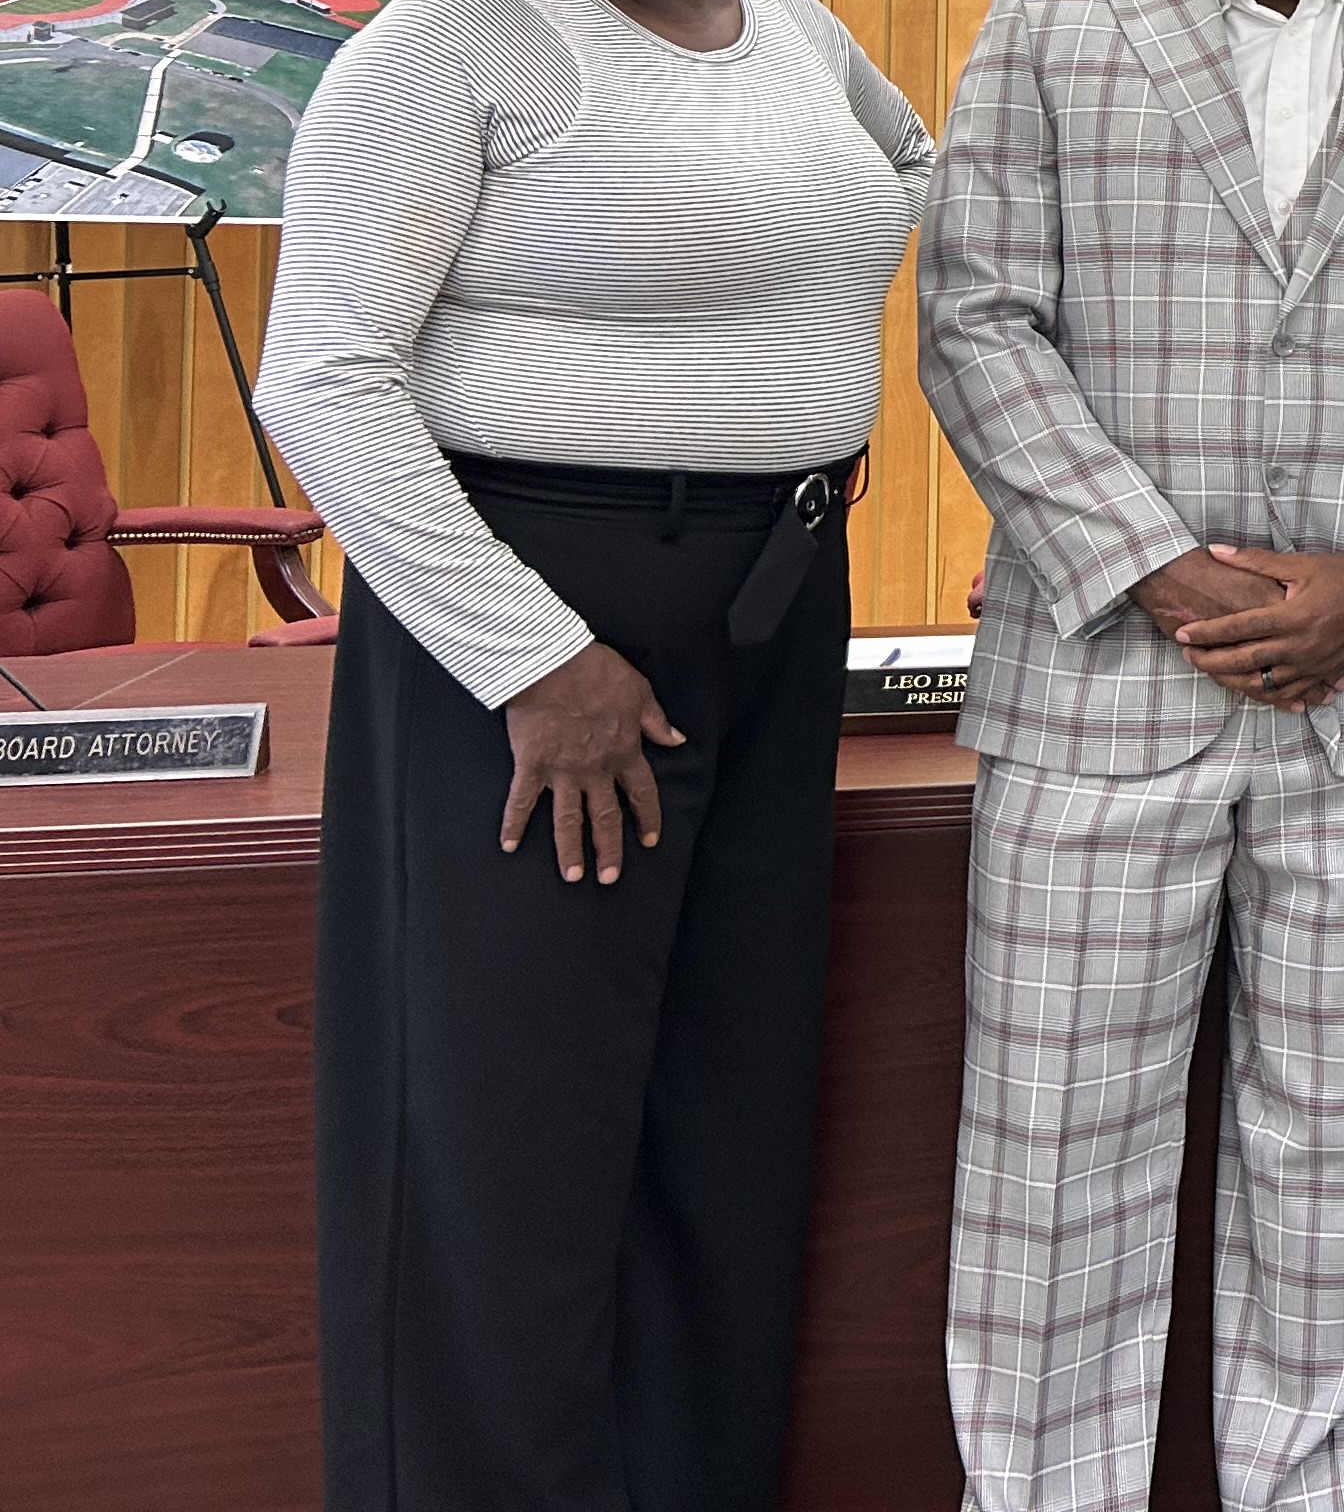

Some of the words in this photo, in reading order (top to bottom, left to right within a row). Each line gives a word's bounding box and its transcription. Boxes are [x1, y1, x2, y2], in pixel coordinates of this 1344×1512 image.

[882, 674, 932, 690] LEO
[937, 673, 968, 688] BR
[0, 735, 76, 761] BOARD
[87, 729, 221, 757] ATTORNEY
